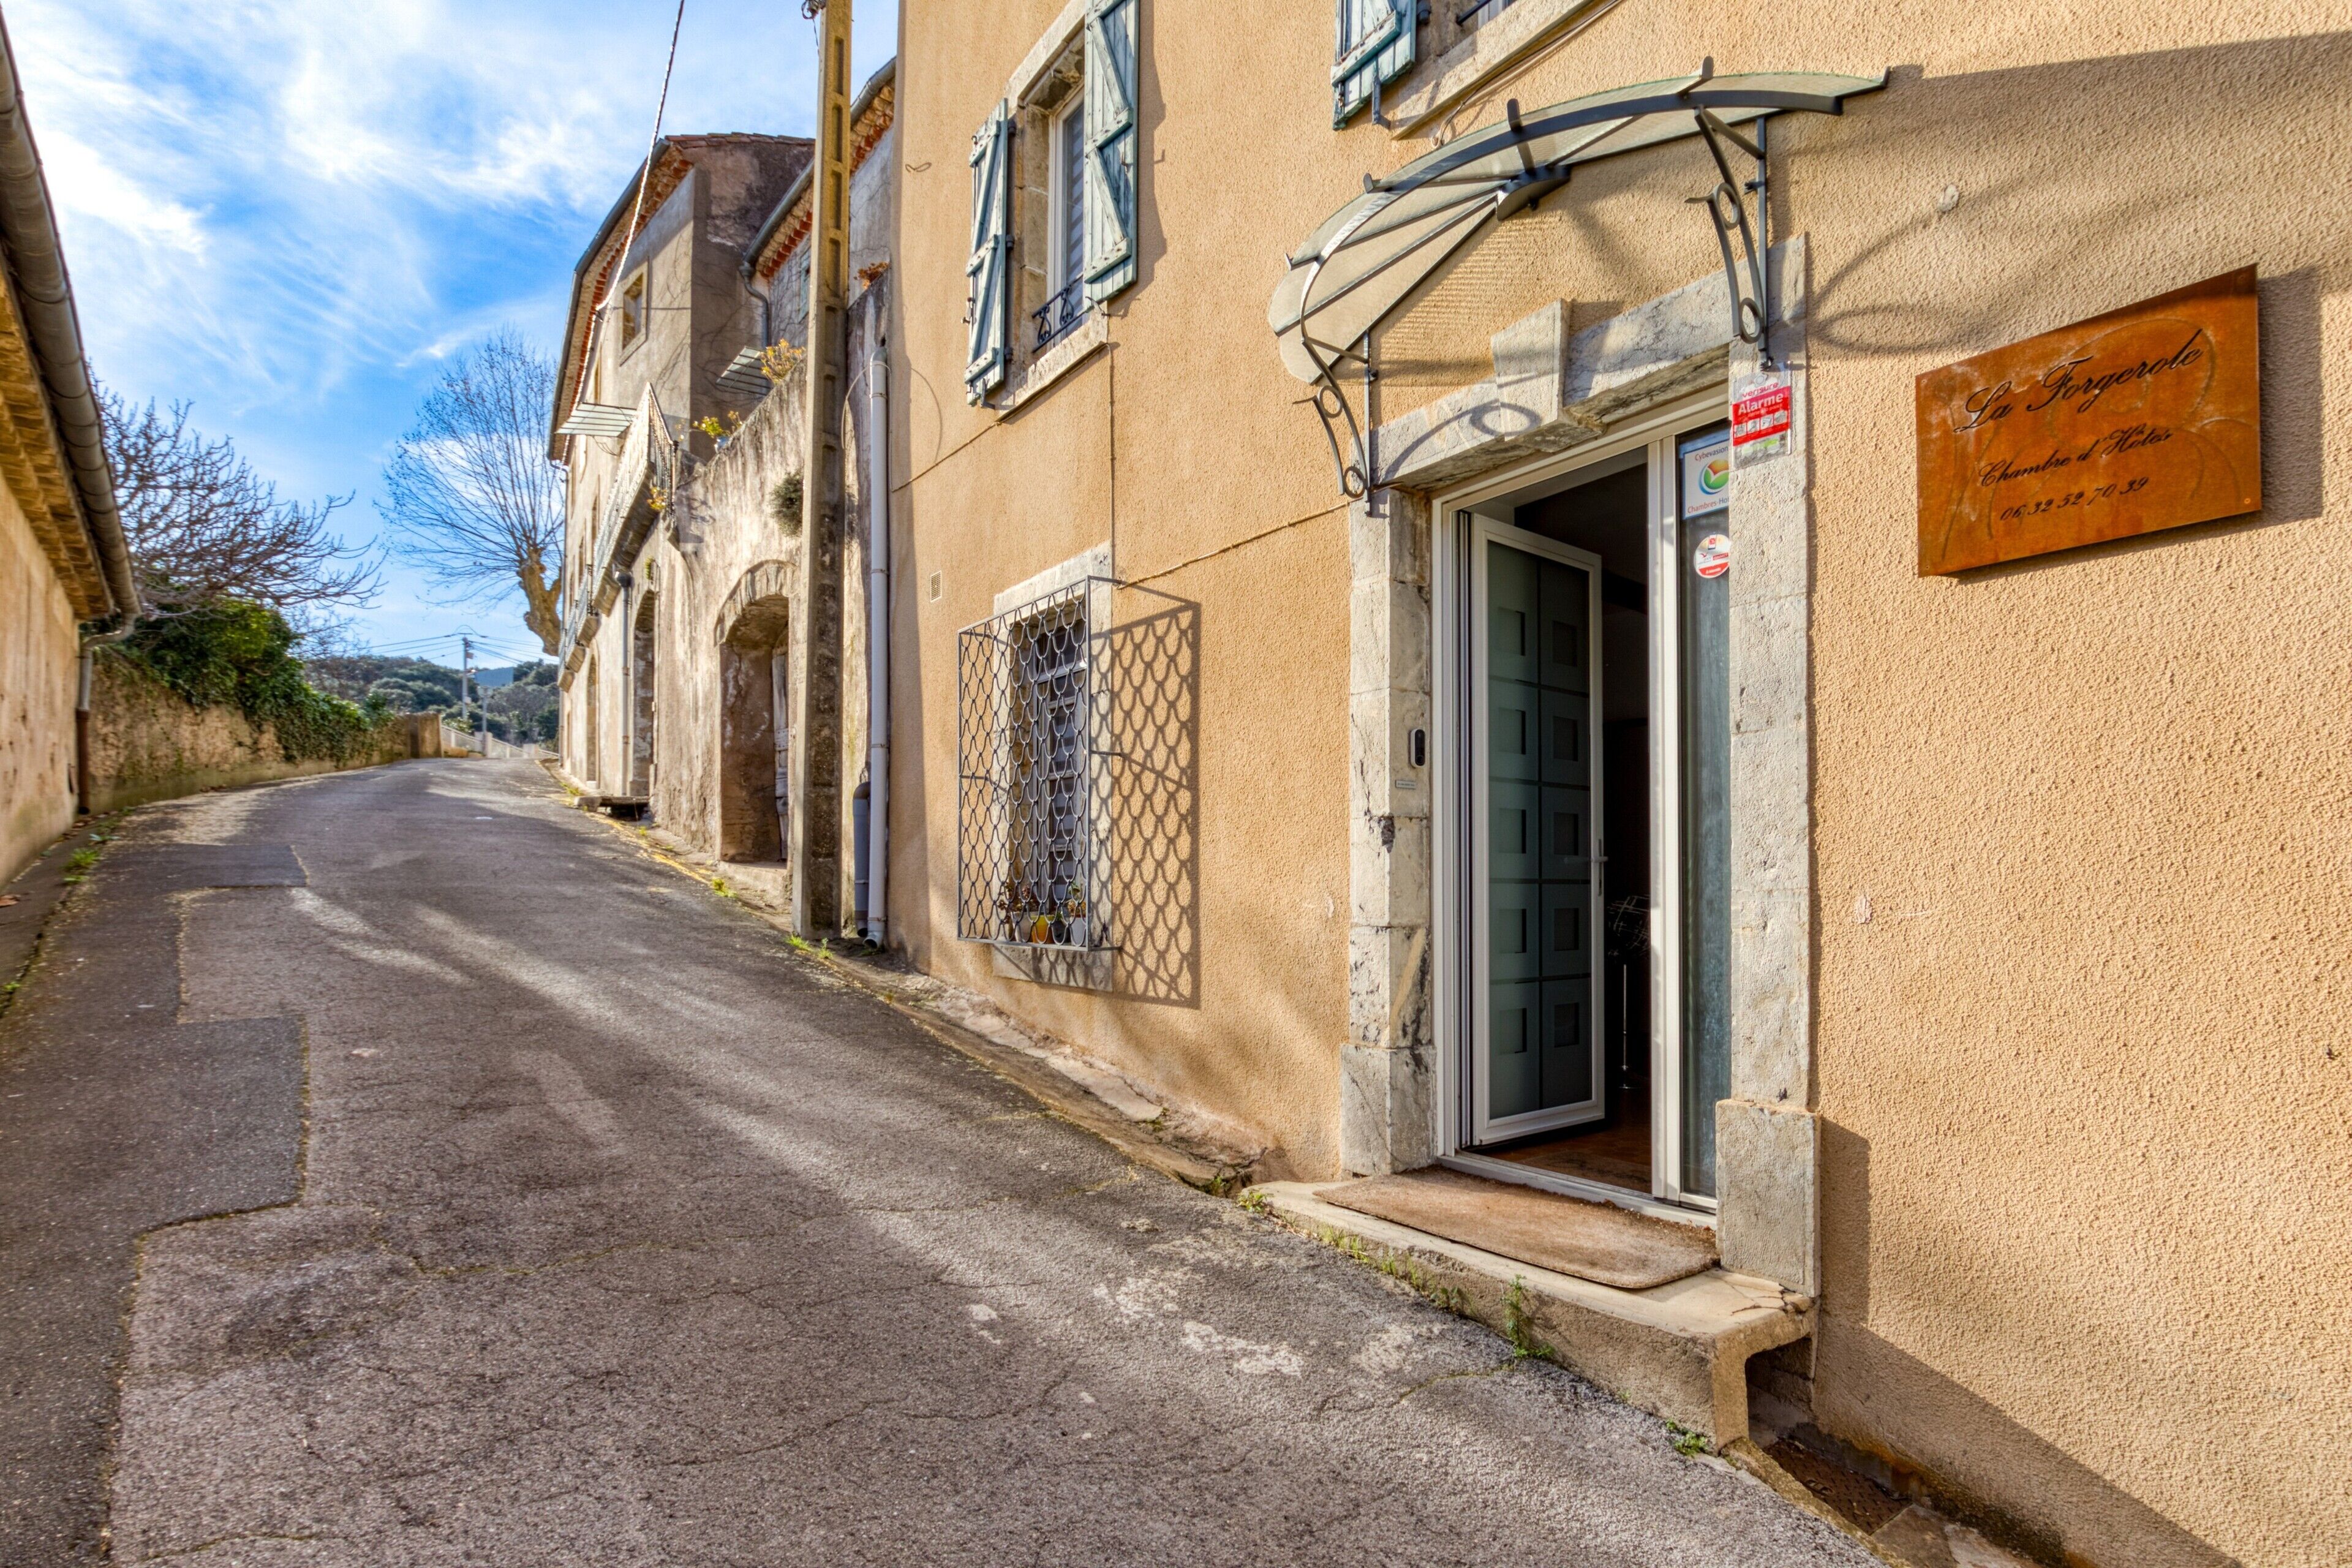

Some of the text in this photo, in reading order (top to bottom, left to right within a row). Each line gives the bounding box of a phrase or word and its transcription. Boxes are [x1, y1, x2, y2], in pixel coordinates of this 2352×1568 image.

[1742, 382, 1779, 398] verisure
[1953, 328, 2204, 432] La Forgerole
[1738, 393, 1784, 415] Alarme
[1695, 446, 1728, 461] Cybevasion
[1979, 450, 2071, 486] Chambre
[2000, 476, 2149, 521] 06 32 52 70 39
